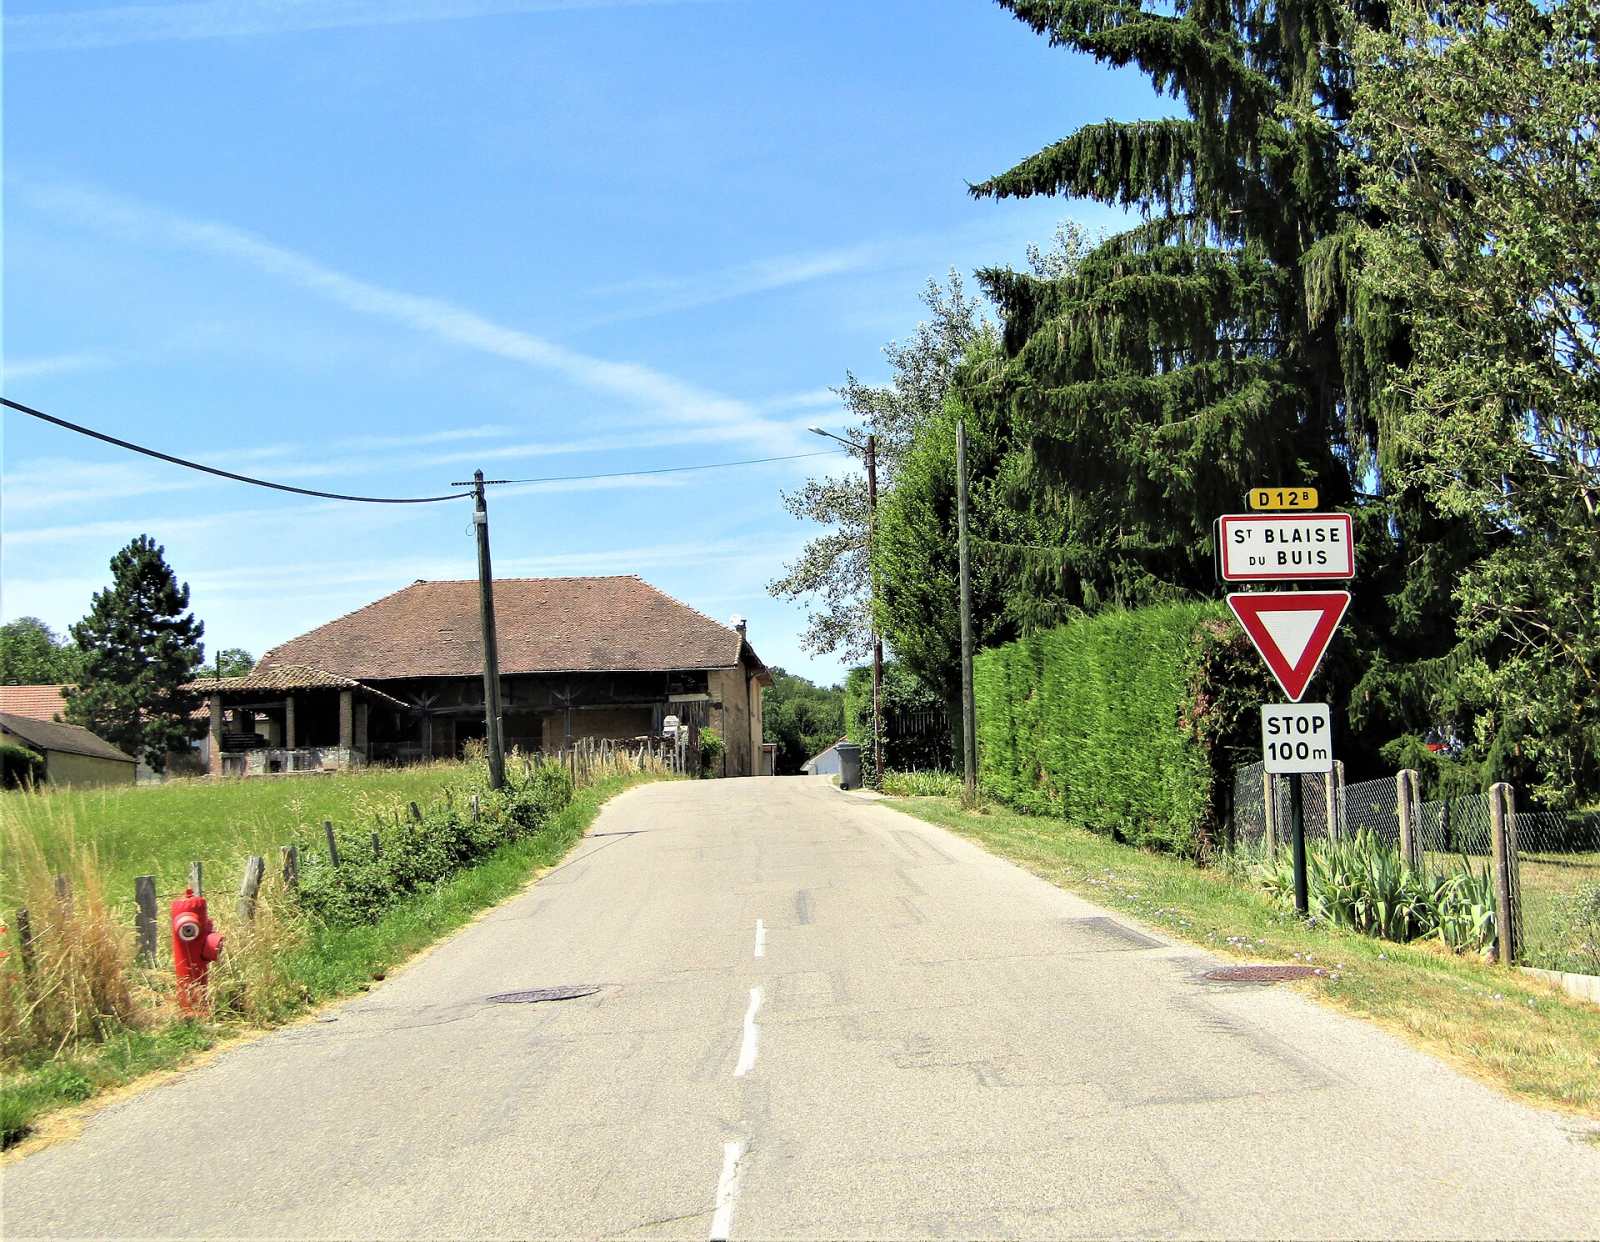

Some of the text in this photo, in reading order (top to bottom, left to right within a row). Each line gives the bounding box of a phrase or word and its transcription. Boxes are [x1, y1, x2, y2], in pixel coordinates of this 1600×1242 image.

[1265, 528, 1340, 544] BLAISE
[1249, 550, 1328, 566] DU BUIS
[1268, 716, 1324, 734] STOP
